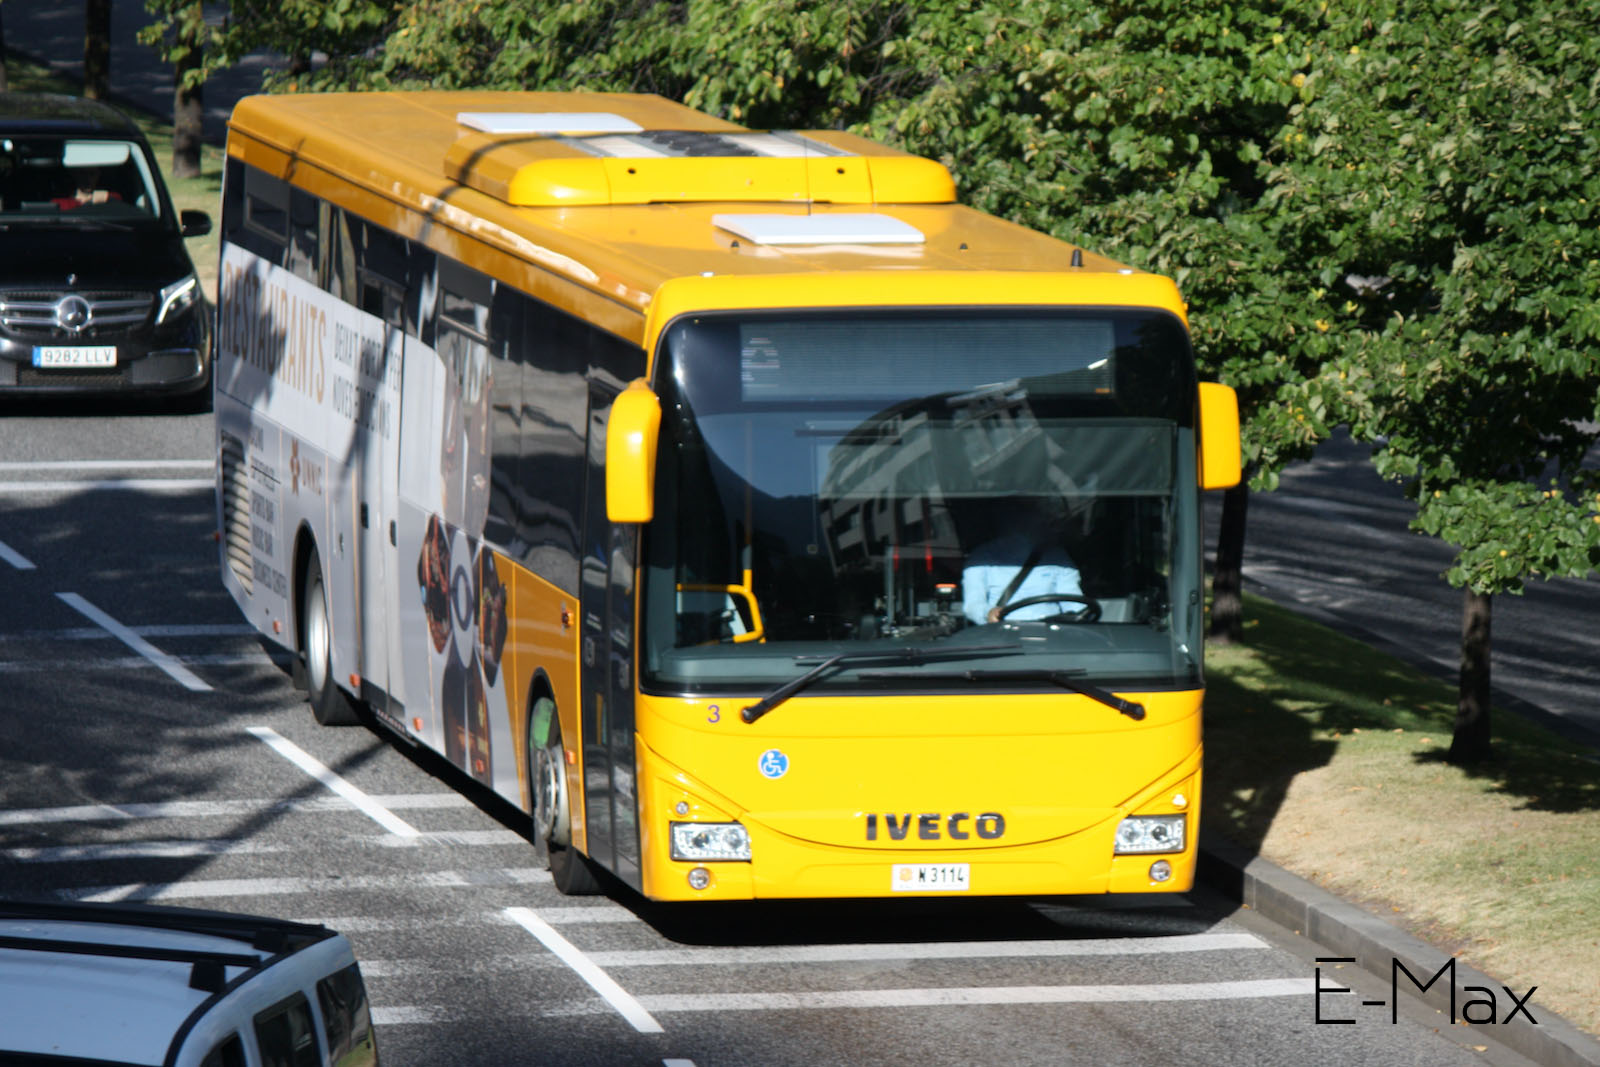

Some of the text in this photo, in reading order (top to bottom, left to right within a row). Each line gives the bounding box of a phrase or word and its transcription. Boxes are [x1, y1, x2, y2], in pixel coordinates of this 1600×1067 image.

[222, 260, 327, 404] RESTAURANTS
[44, 348, 111, 362] 9282 LLV
[706, 703, 720, 723] 3
[866, 812, 1006, 841] IVECO
